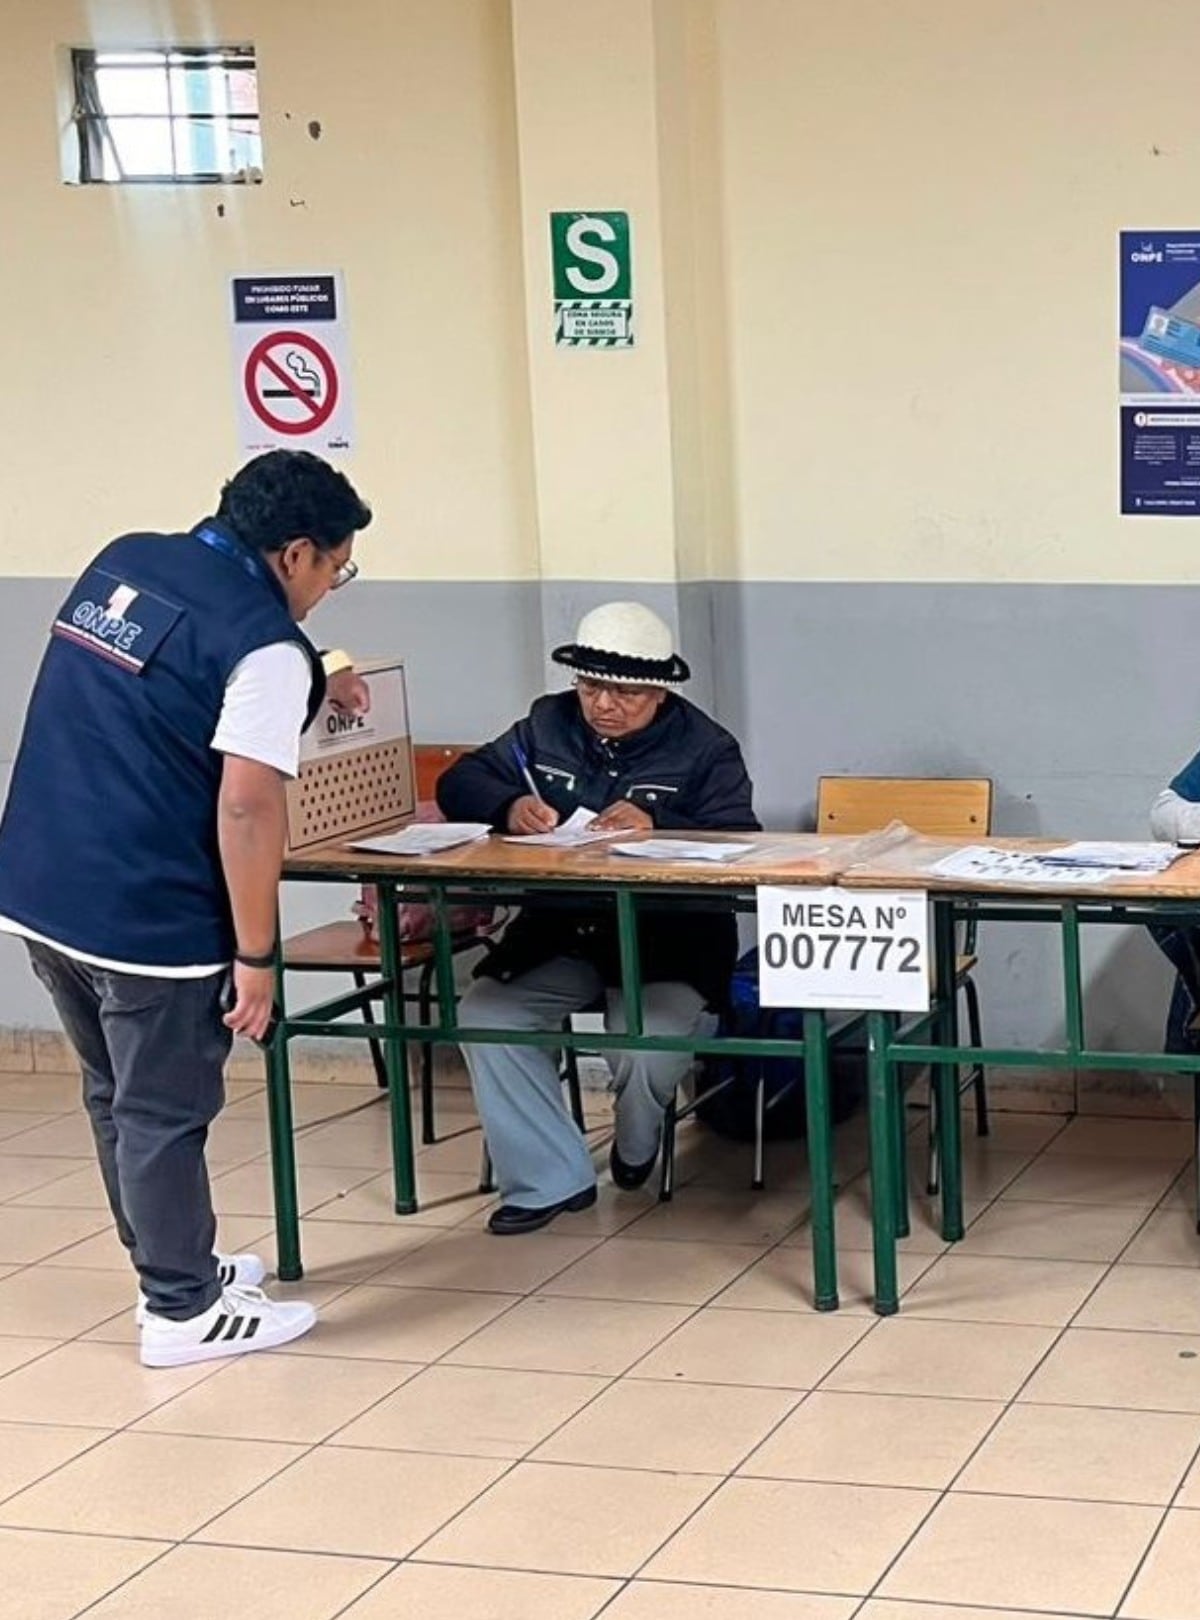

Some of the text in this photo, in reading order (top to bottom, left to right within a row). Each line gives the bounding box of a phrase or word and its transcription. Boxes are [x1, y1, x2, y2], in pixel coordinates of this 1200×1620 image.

[565, 216, 619, 294] S
[1131, 252, 1163, 263] ONPE
[72, 601, 143, 650] ONPE
[326, 713, 365, 734] ONPE
[782, 903, 867, 929] MESA
[764, 932, 922, 973] 007772
